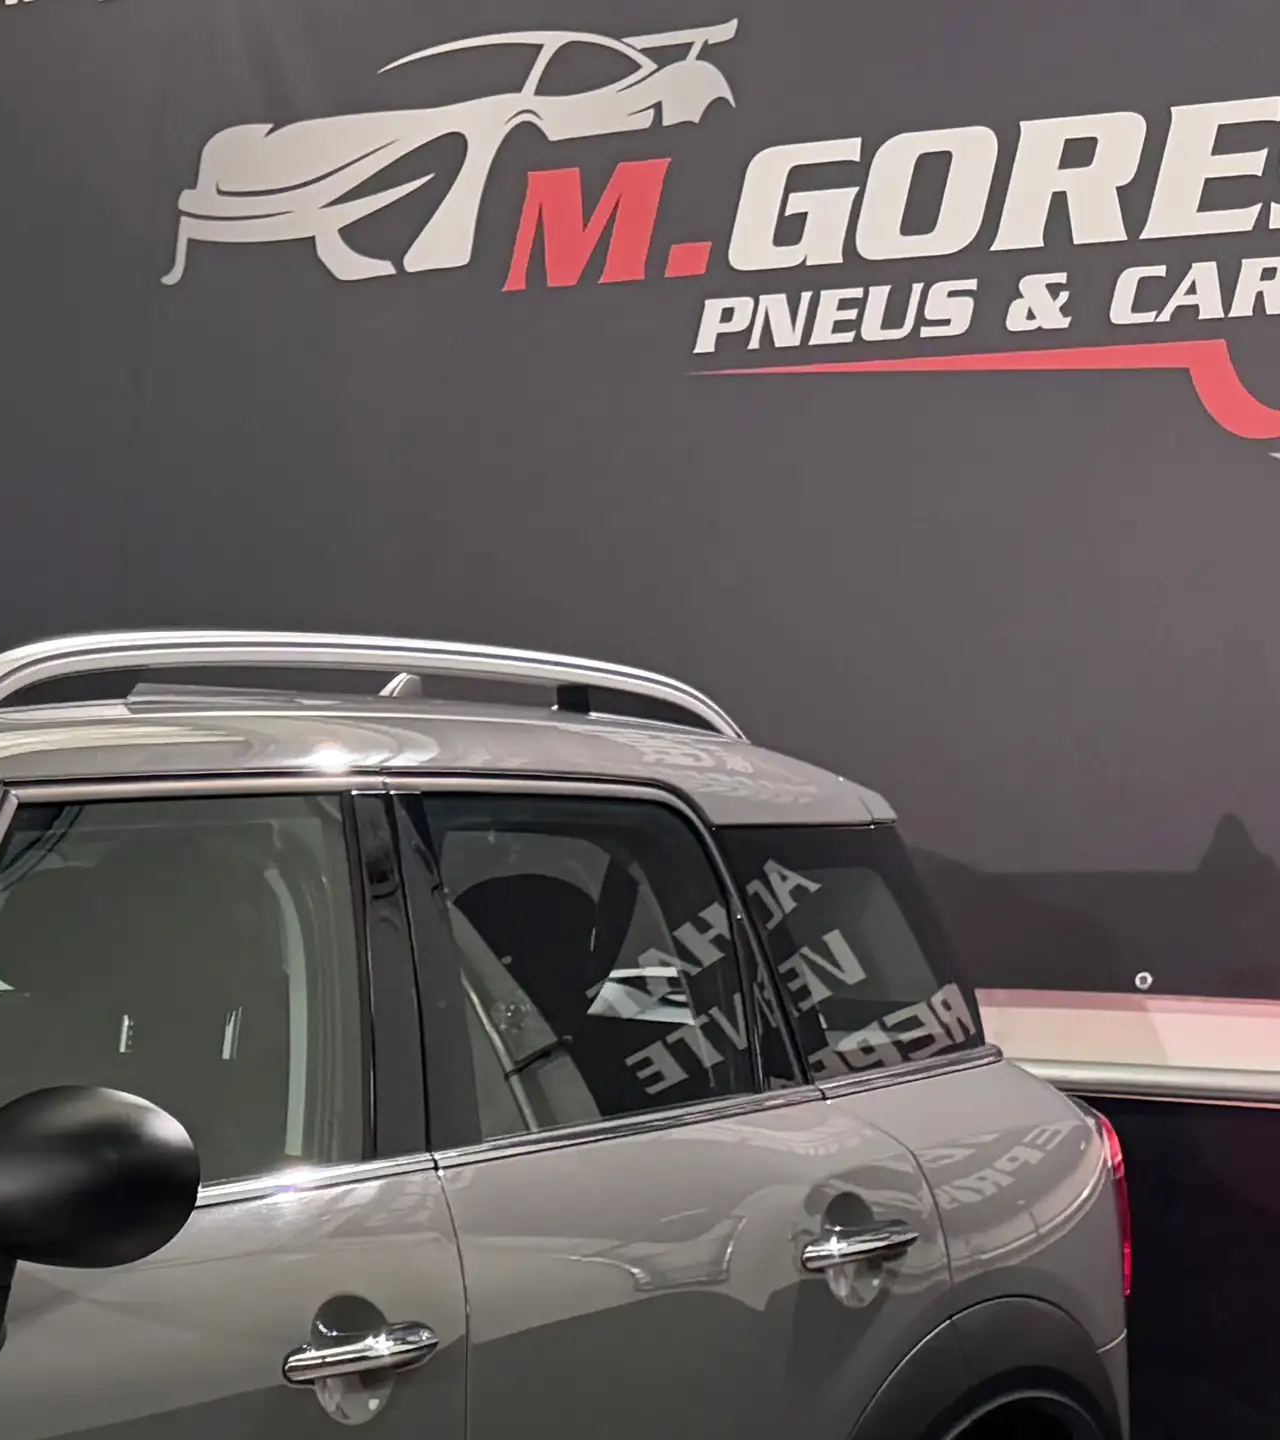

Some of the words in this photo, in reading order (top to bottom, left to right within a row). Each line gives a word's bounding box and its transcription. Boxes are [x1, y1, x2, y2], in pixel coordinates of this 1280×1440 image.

[502, 96, 1280, 292] M.GORE
[692, 278, 978, 354] PNEUS
[1005, 272, 1072, 332] &
[1109, 256, 1280, 325] CAR
